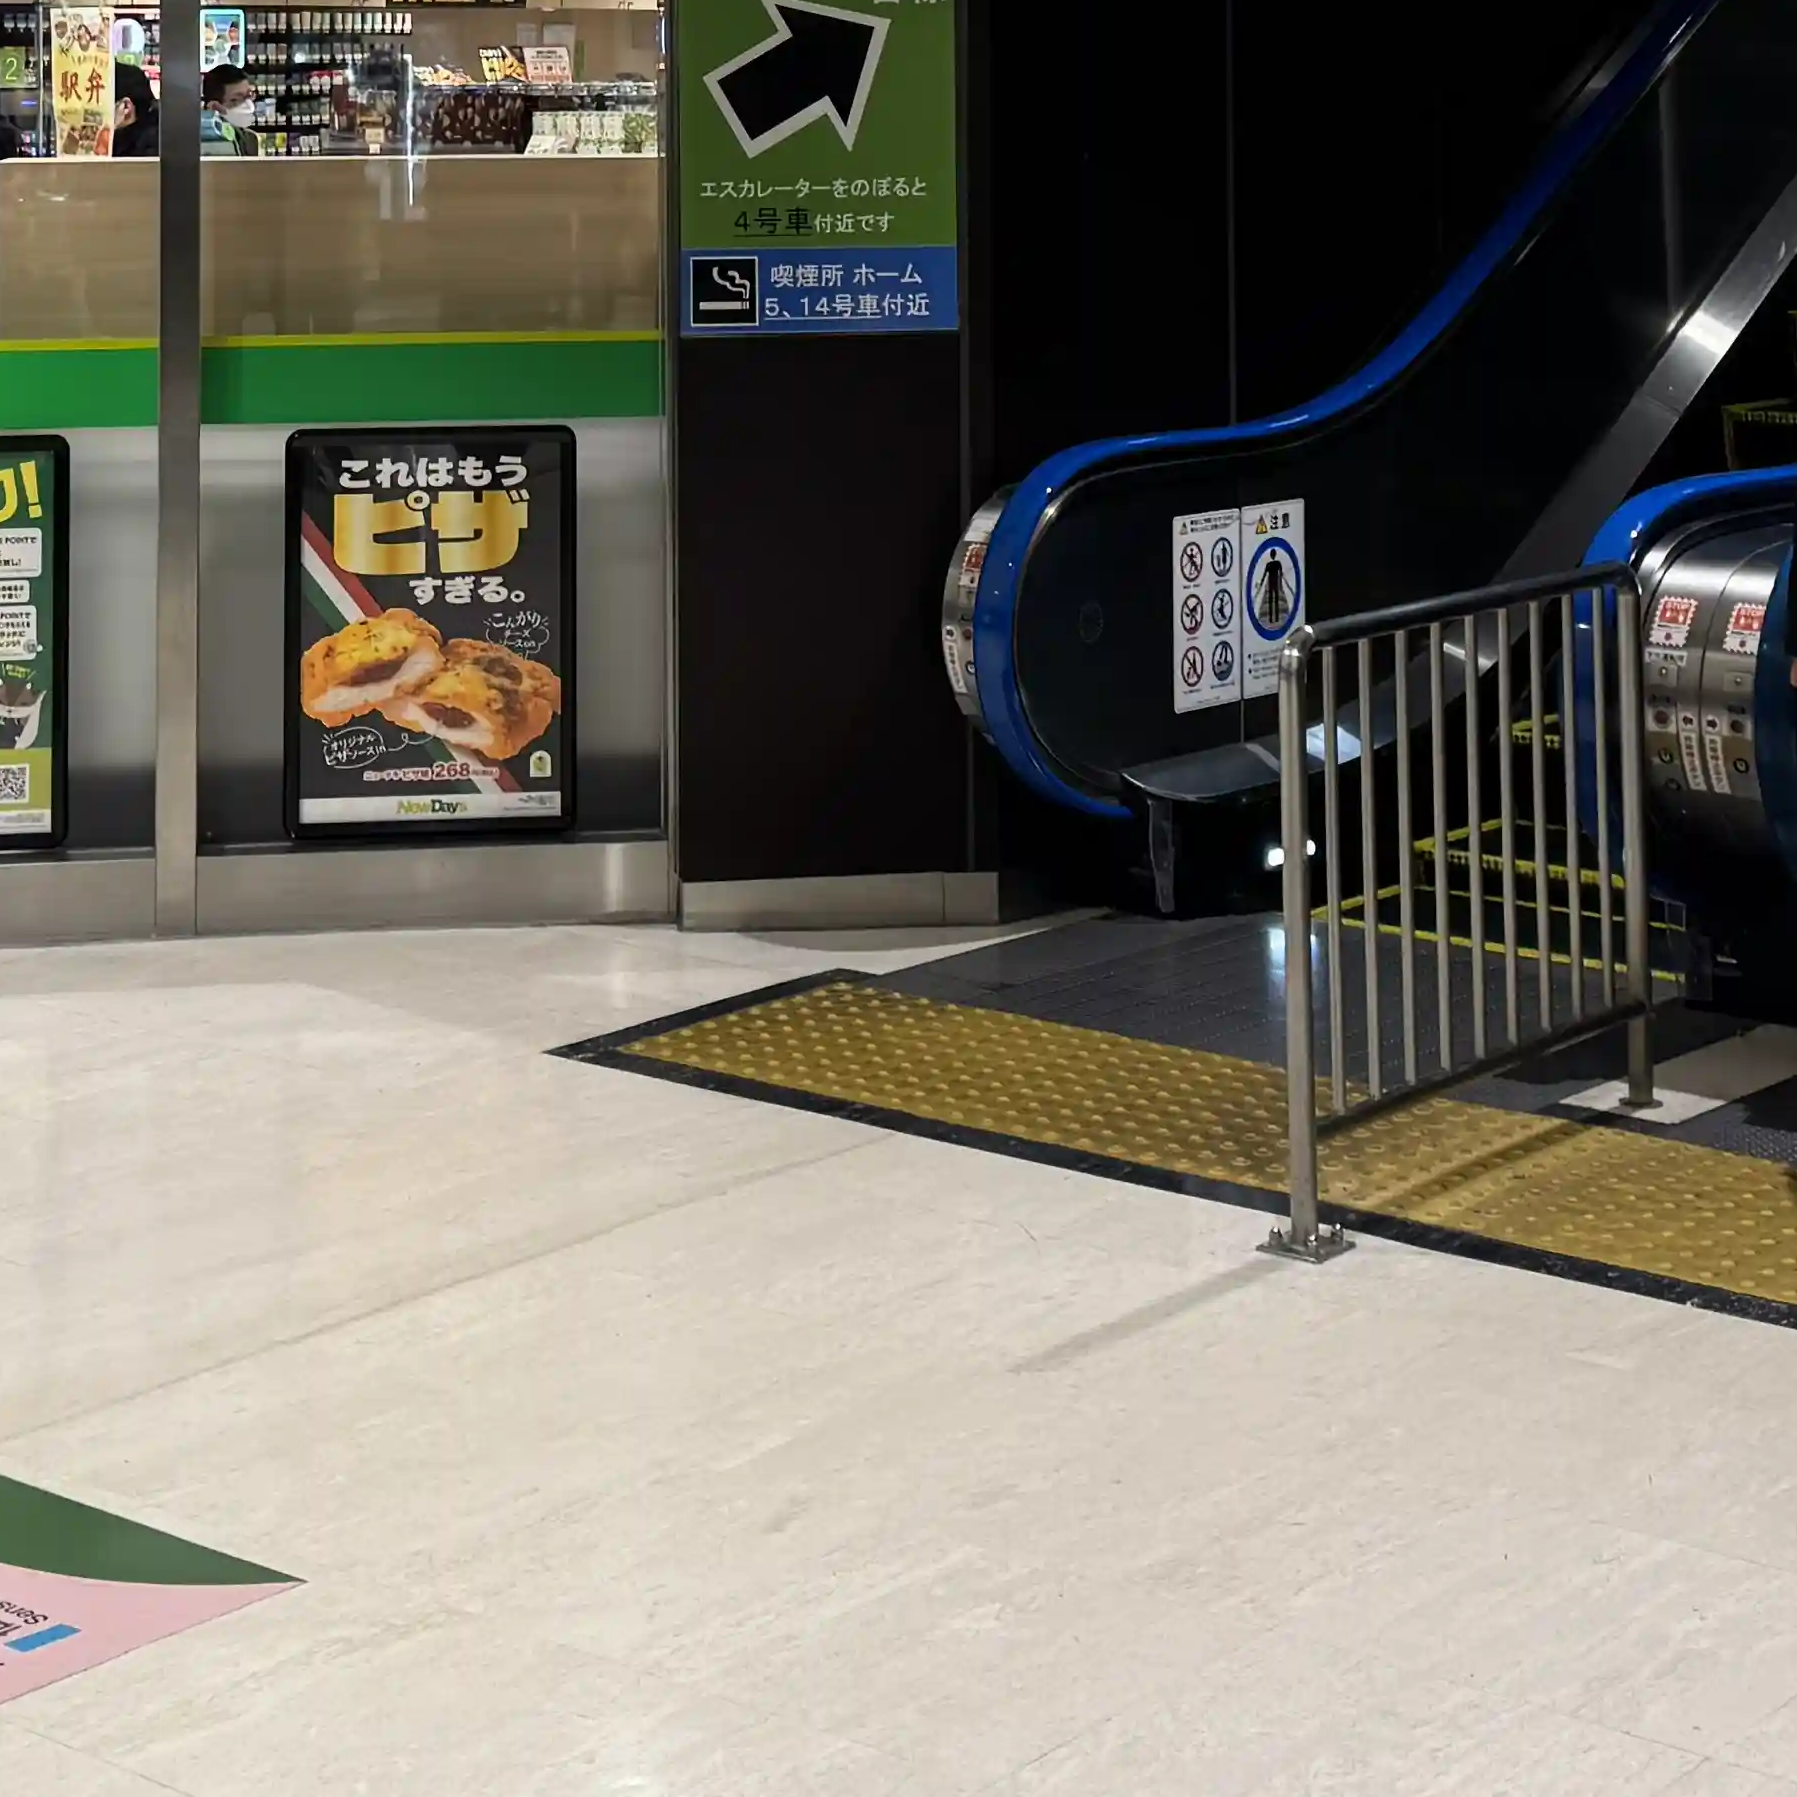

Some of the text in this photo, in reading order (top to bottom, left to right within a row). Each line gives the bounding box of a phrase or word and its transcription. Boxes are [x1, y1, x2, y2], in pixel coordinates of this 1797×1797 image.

[5, 56, 17, 80] 2
[60, 68, 105, 105] 駅弁
[700, 176, 927, 200] エスカレーターをのぼると
[734, 206, 895, 236] 4号車付近です
[770, 263, 923, 288] 喫煙所 ホーム
[764, 293, 929, 319] 5、14号車付近
[339, 456, 528, 489] これはもう
[333, 489, 529, 575] ピザ
[408, 577, 524, 606] すぎる。
[397, 799, 468, 814] NewDays
